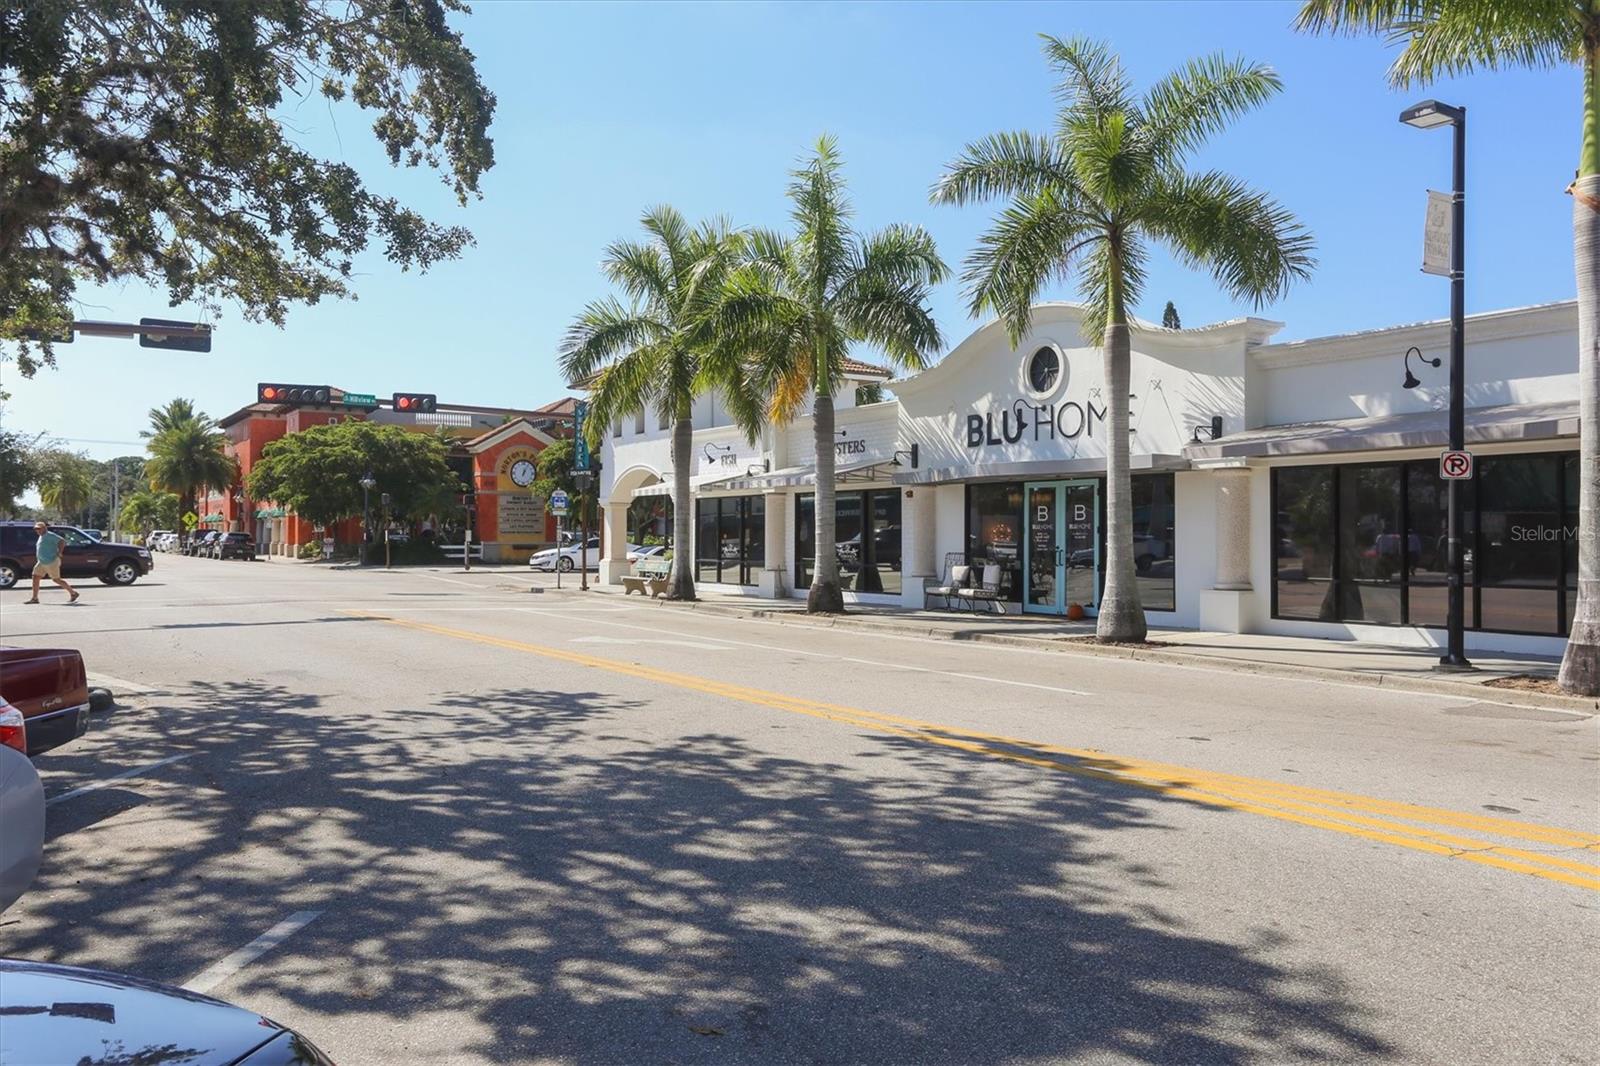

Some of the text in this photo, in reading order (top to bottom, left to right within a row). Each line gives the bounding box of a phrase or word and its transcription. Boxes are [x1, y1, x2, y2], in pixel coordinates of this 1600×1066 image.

[967, 408, 1023, 448] BLU
[834, 440, 865, 455] STERS
[1037, 505, 1049, 521] B
[1074, 504, 1086, 521] B
